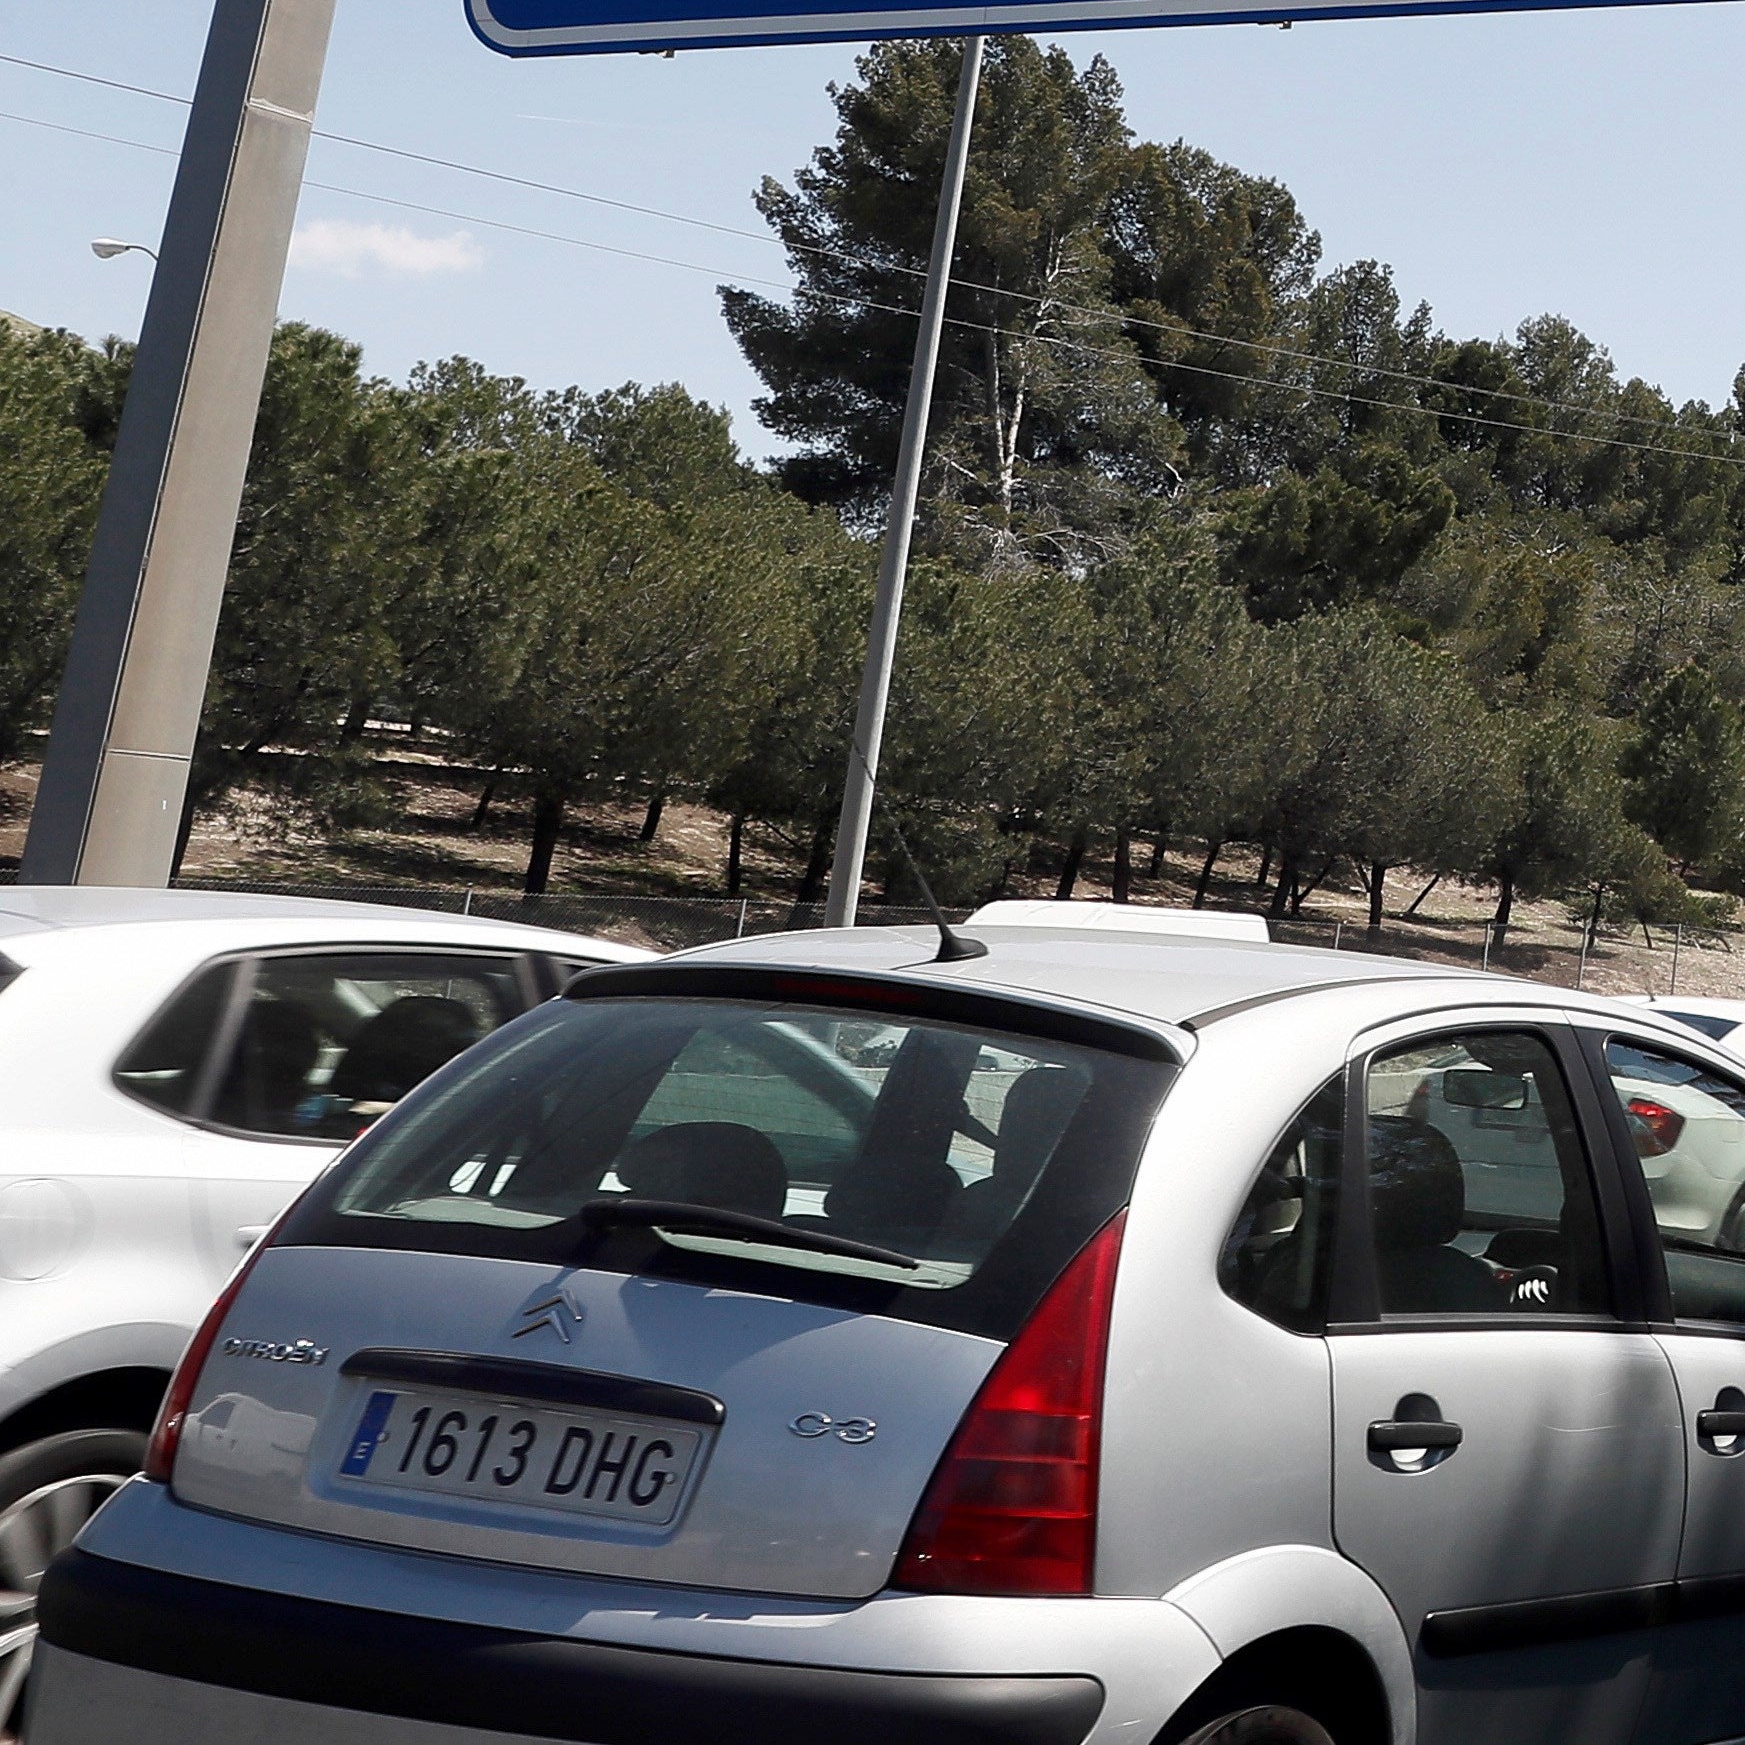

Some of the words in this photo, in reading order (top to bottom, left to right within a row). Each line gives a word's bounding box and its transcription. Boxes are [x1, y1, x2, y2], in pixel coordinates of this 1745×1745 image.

[397, 1406, 538, 1487] 1613
[543, 1426, 675, 1507] DHG
[788, 1410, 877, 1445] C3
